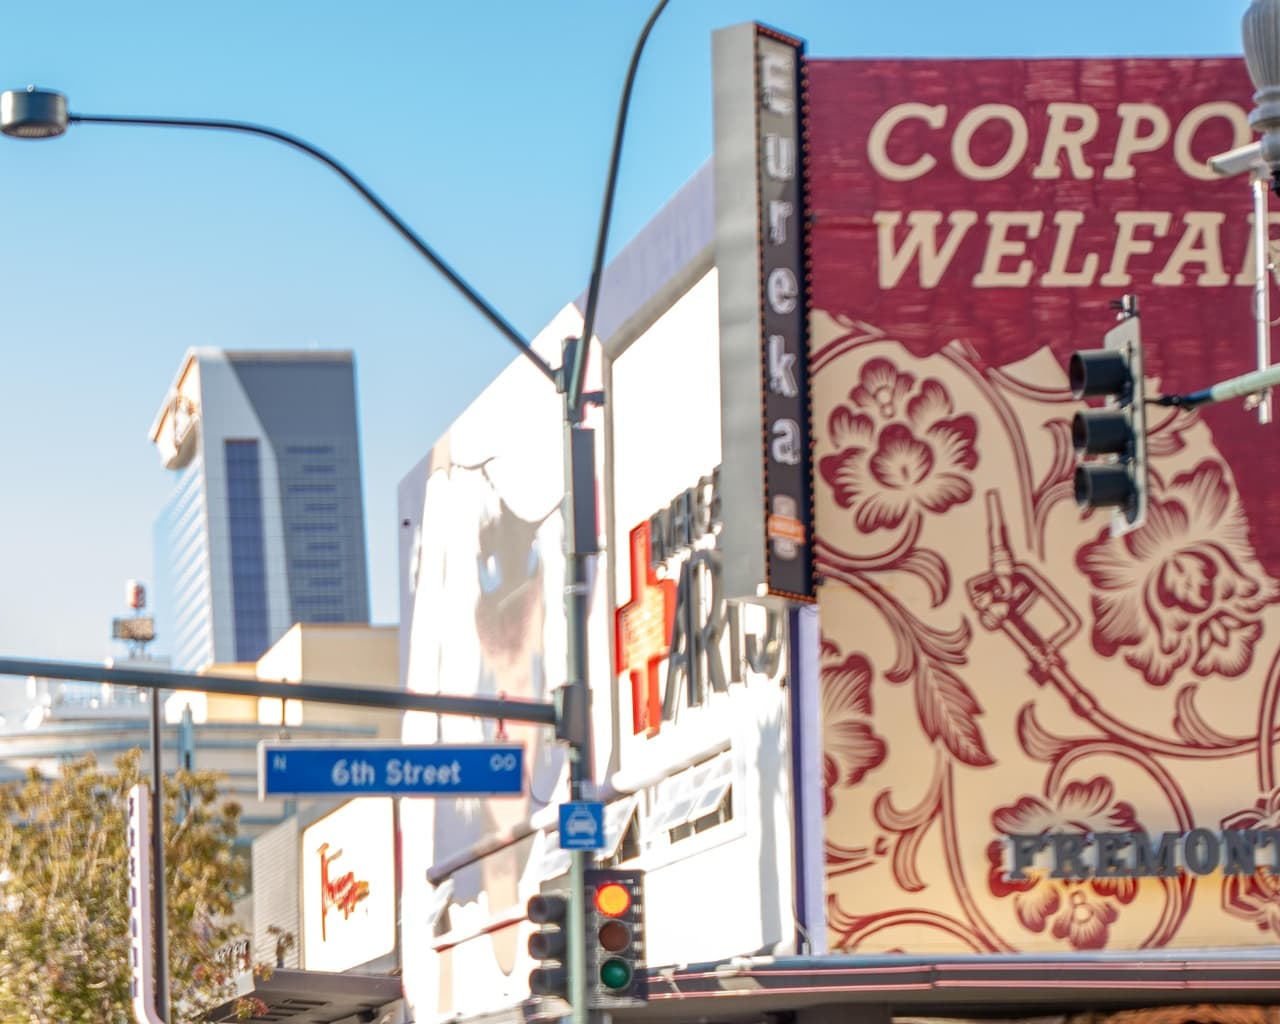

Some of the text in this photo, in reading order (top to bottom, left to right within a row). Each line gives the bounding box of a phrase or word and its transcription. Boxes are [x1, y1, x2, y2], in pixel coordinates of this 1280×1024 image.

[274, 755, 287, 771] N
[332, 759, 375, 786] 6th
[386, 759, 462, 786] Street
